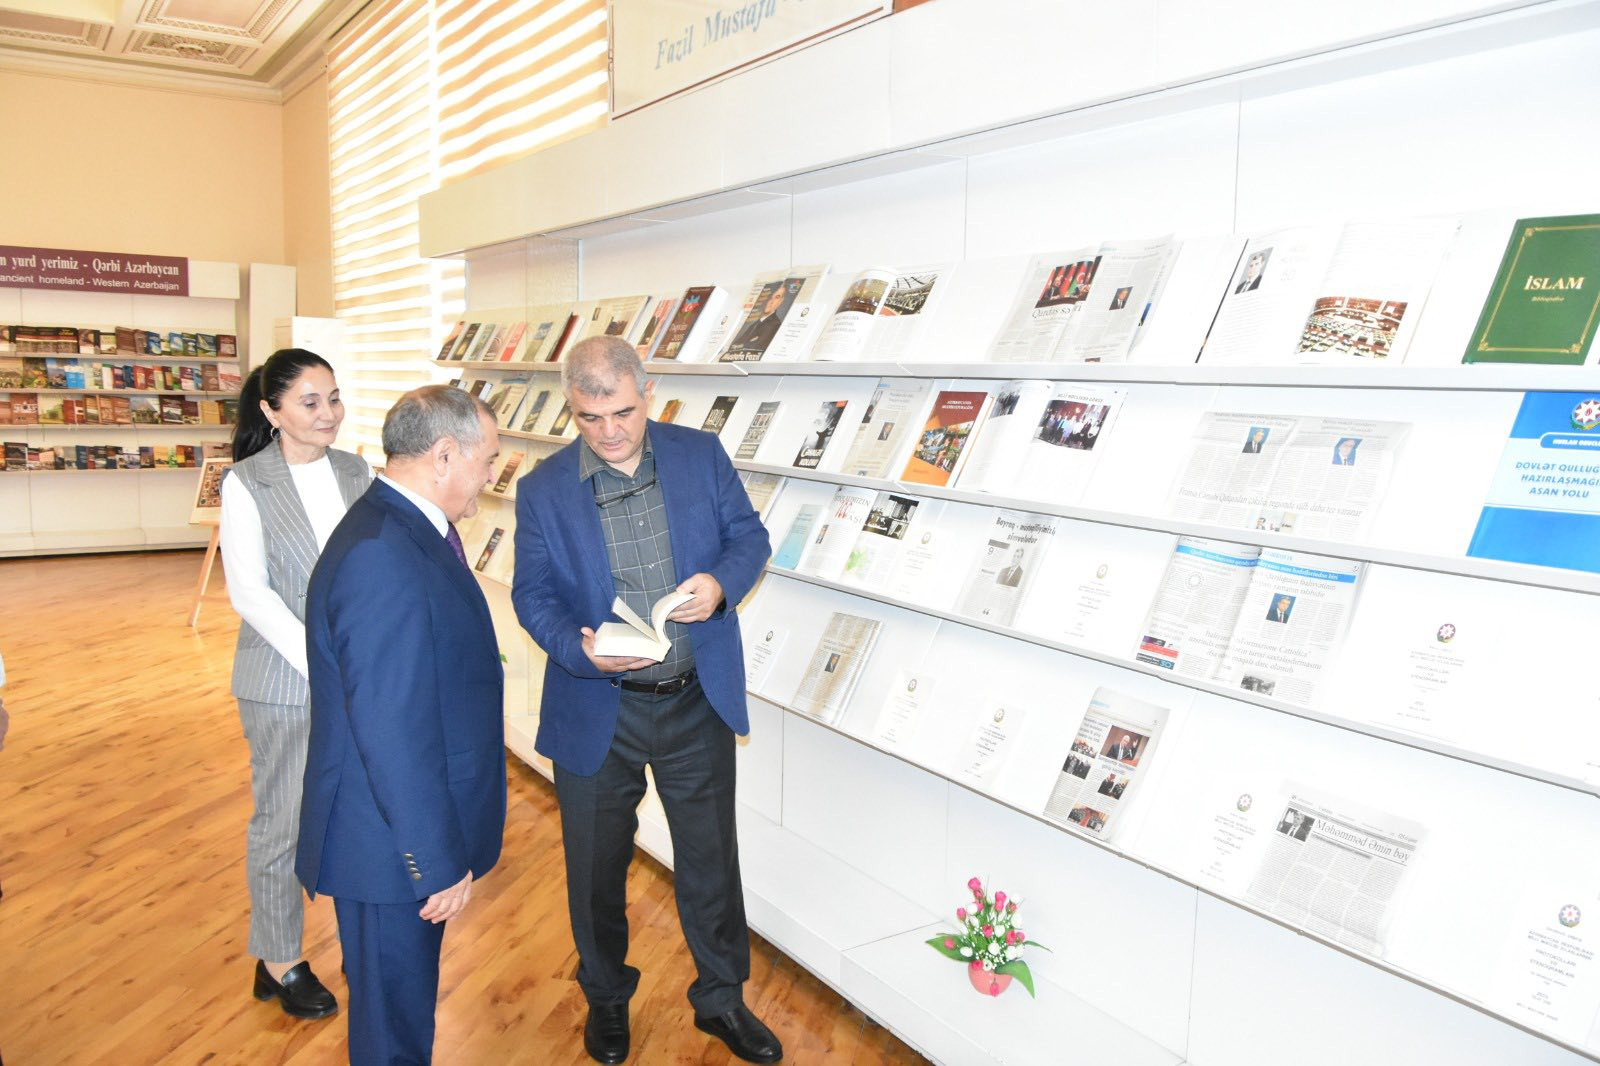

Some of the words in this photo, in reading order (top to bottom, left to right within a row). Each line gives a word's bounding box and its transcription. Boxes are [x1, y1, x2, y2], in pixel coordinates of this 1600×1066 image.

[655, 24, 695, 69] Fazil
[12, 255, 37, 270] yurd
[41, 256, 79, 271] yerimiz
[93, 259, 121, 274] Qərbi
[125, 260, 180, 278] Azərbaycan
[0, 275, 34, 283] ancient
[39, 276, 85, 286] homeland
[93, 278, 130, 288] Western
[134, 280, 180, 291] Azerbaijan
[1523, 275, 1585, 291] İSLAM
[1529, 487, 1559, 497] ASAN
[1562, 489, 1590, 498] YOLU
[1315, 819, 1368, 848] Məhəmməd
[1367, 839, 1392, 856] Əmin
